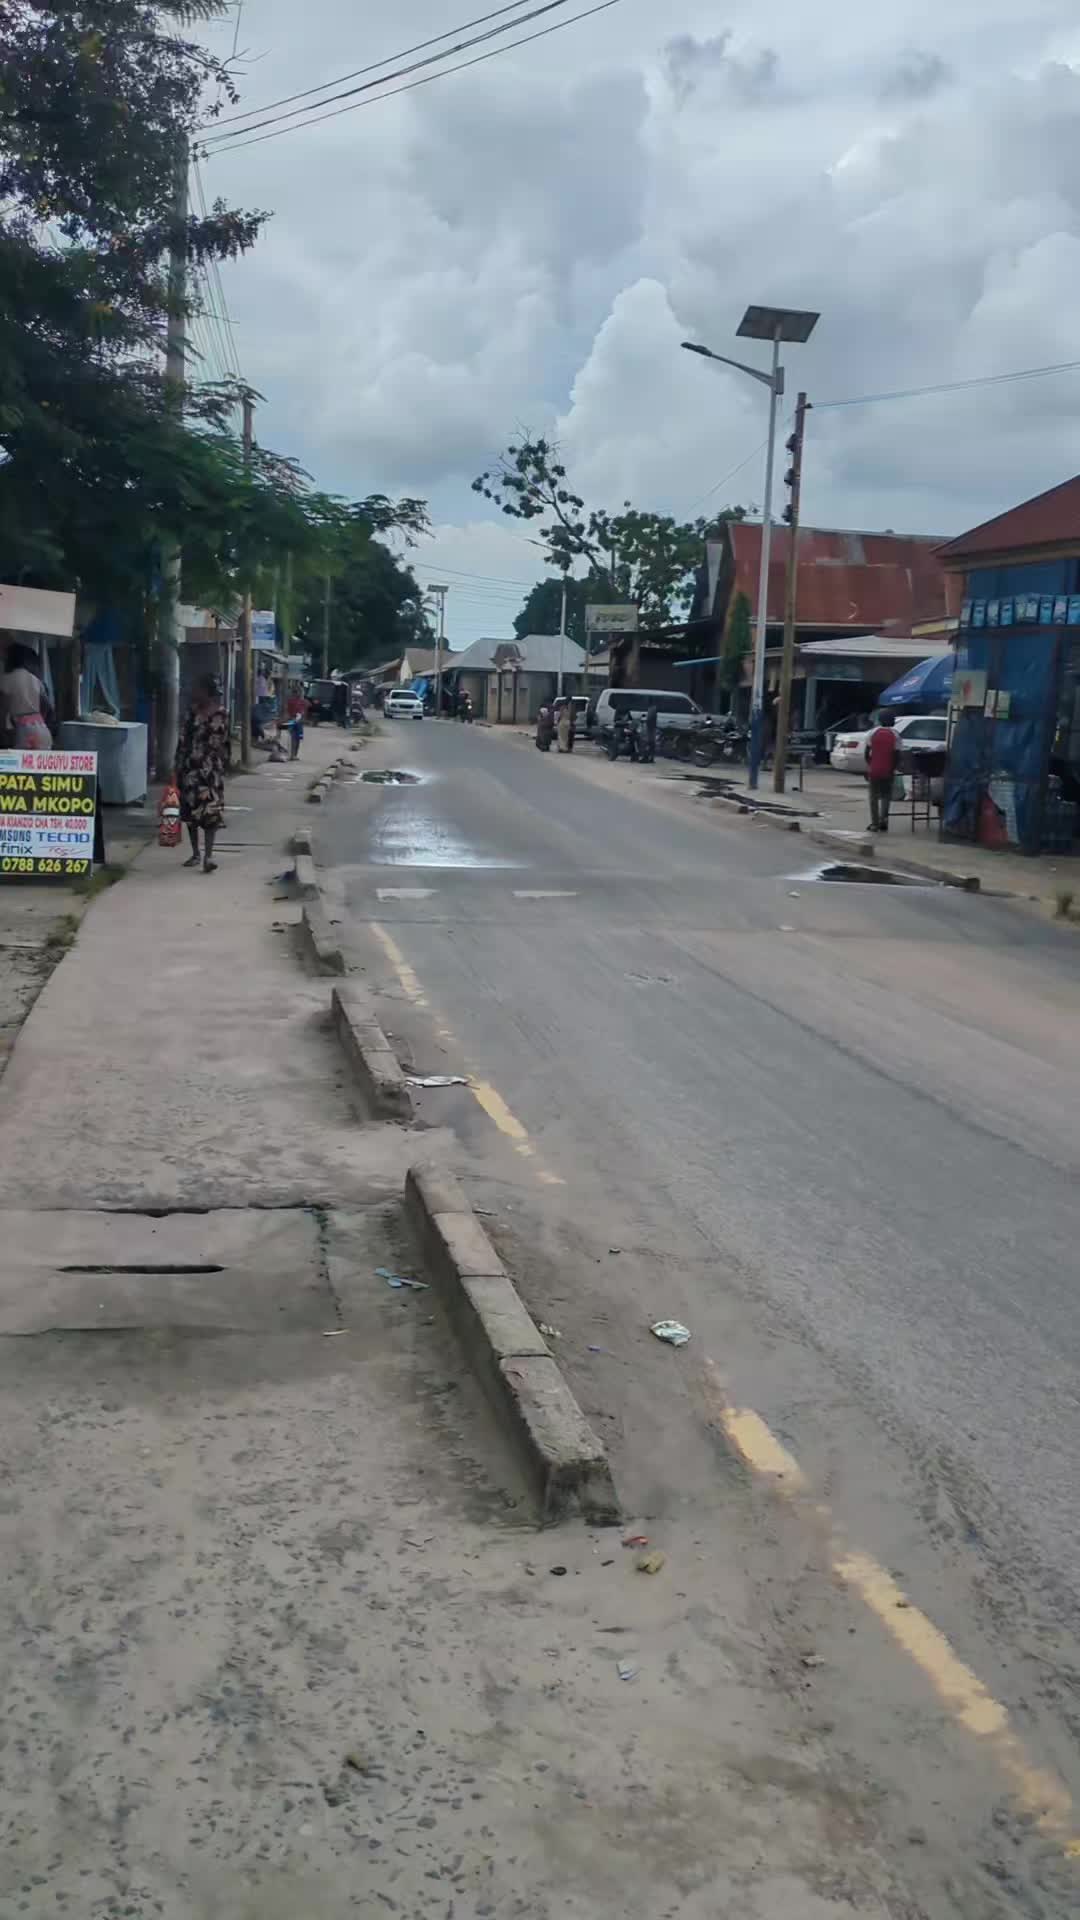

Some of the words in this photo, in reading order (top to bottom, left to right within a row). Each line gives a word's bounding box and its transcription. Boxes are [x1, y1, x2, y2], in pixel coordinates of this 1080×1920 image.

[71, 755, 94, 771] STORE
[0, 775, 36, 791] PATA
[41, 776, 83, 793] SIMU
[33, 796, 94, 813] MKOPO
[36, 832, 90, 843] TECNO
[2, 857, 34, 872] 0788
[38, 858, 61, 873] 626
[65, 859, 89, 873] 267
